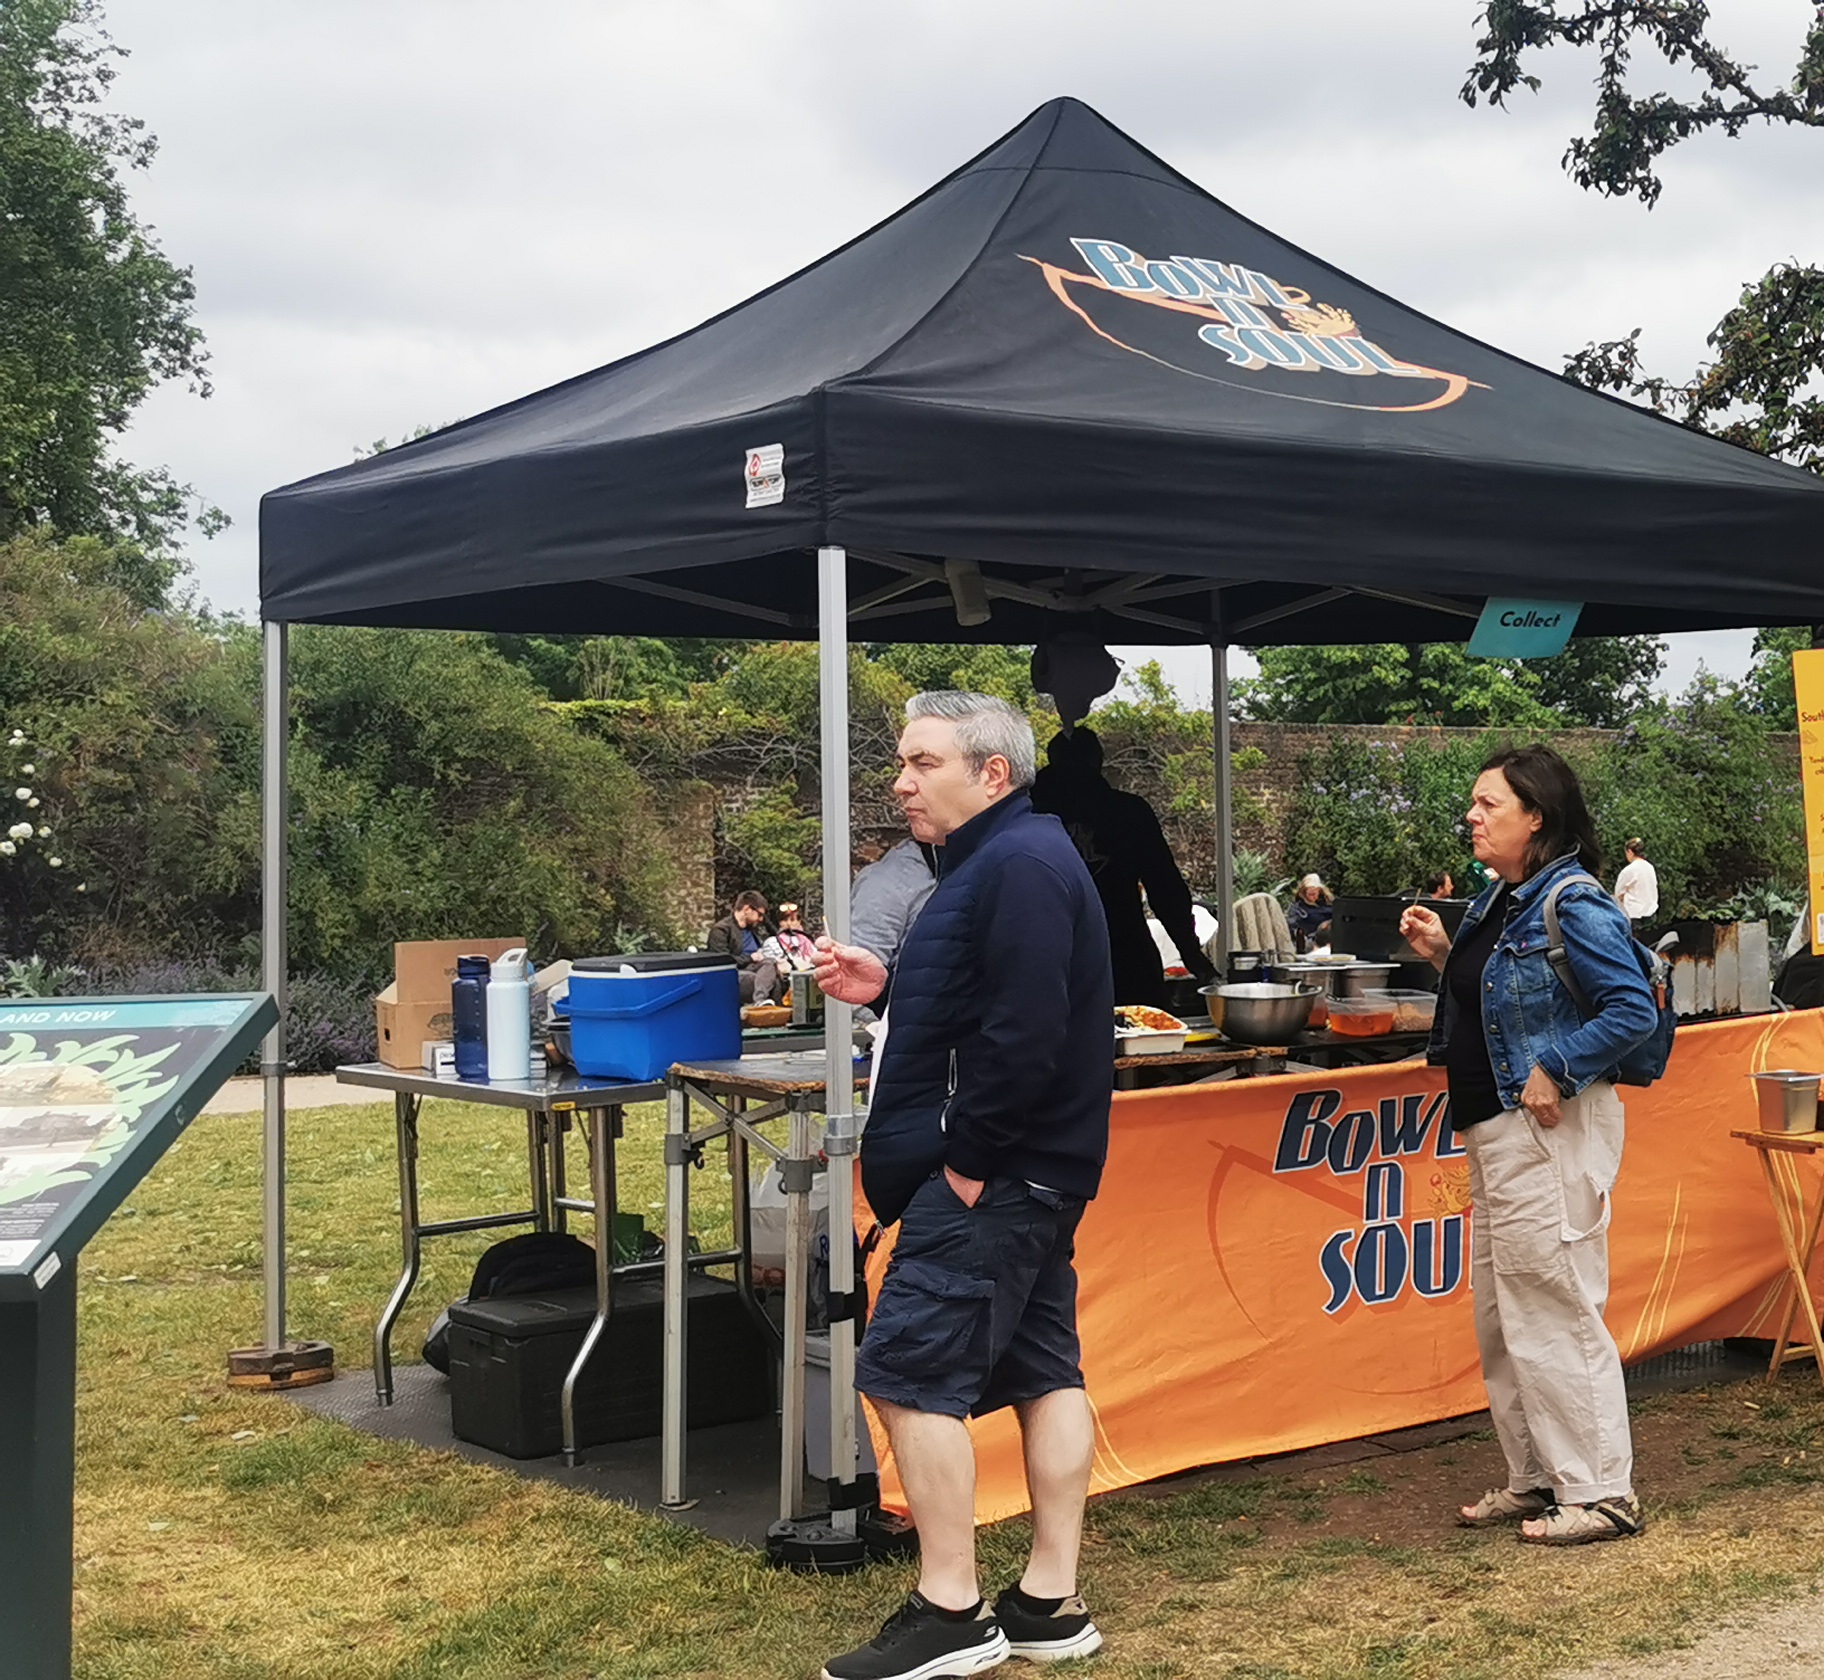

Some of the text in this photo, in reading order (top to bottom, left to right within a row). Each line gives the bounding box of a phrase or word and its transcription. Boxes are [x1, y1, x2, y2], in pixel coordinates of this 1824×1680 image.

[1499, 610, 1562, 628] Collect
[0, 1008, 118, 1024] AND NOW
[1319, 1213, 1473, 1316] SOU
